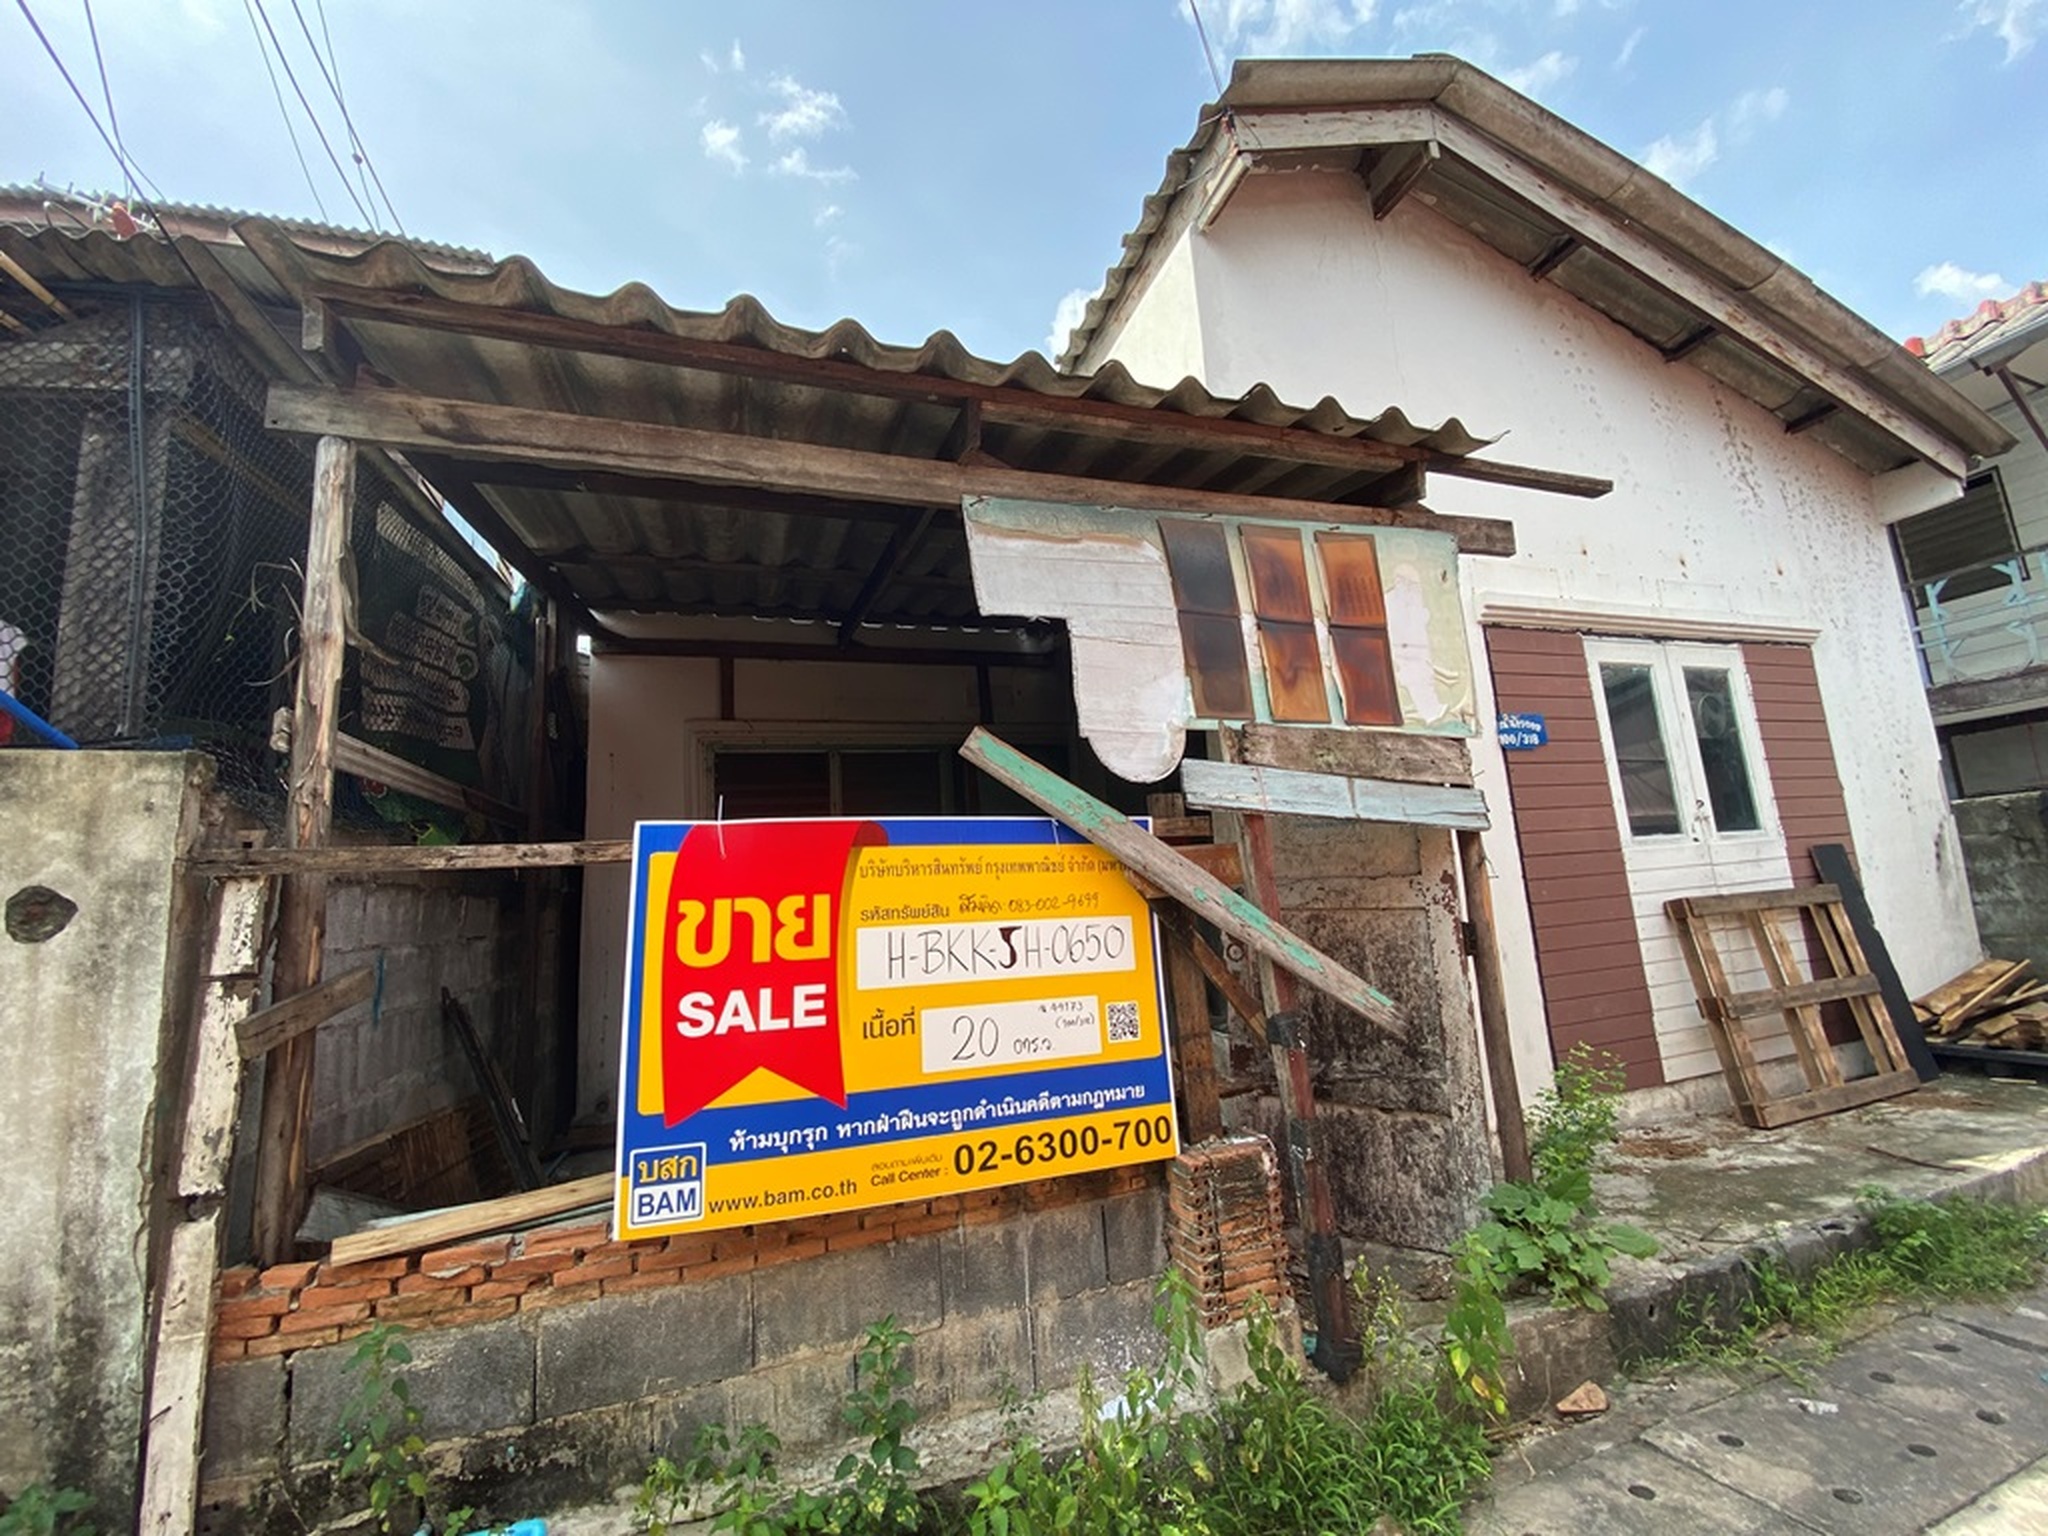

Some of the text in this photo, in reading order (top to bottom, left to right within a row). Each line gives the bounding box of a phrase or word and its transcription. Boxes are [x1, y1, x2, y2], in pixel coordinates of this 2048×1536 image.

[860, 904, 950, 921] รหัสทรัพย์สิน
[676, 894, 830, 968] ขาย
[676, 984, 827, 1038] SALE
[862, 1006, 916, 1040] เนื้อที่
[952, 1015, 999, 1061] 20
[729, 1125, 828, 1153] ห้ามบุกรุก
[953, 1115, 1172, 1176] 02-6300-700
[638, 1154, 698, 1183] บสก
[871, 1172, 896, 1187] Call
[899, 1168, 941, 1183] Center
[637, 1187, 697, 1218] BAM
[708, 1179, 857, 1214] www.bam.co.th
